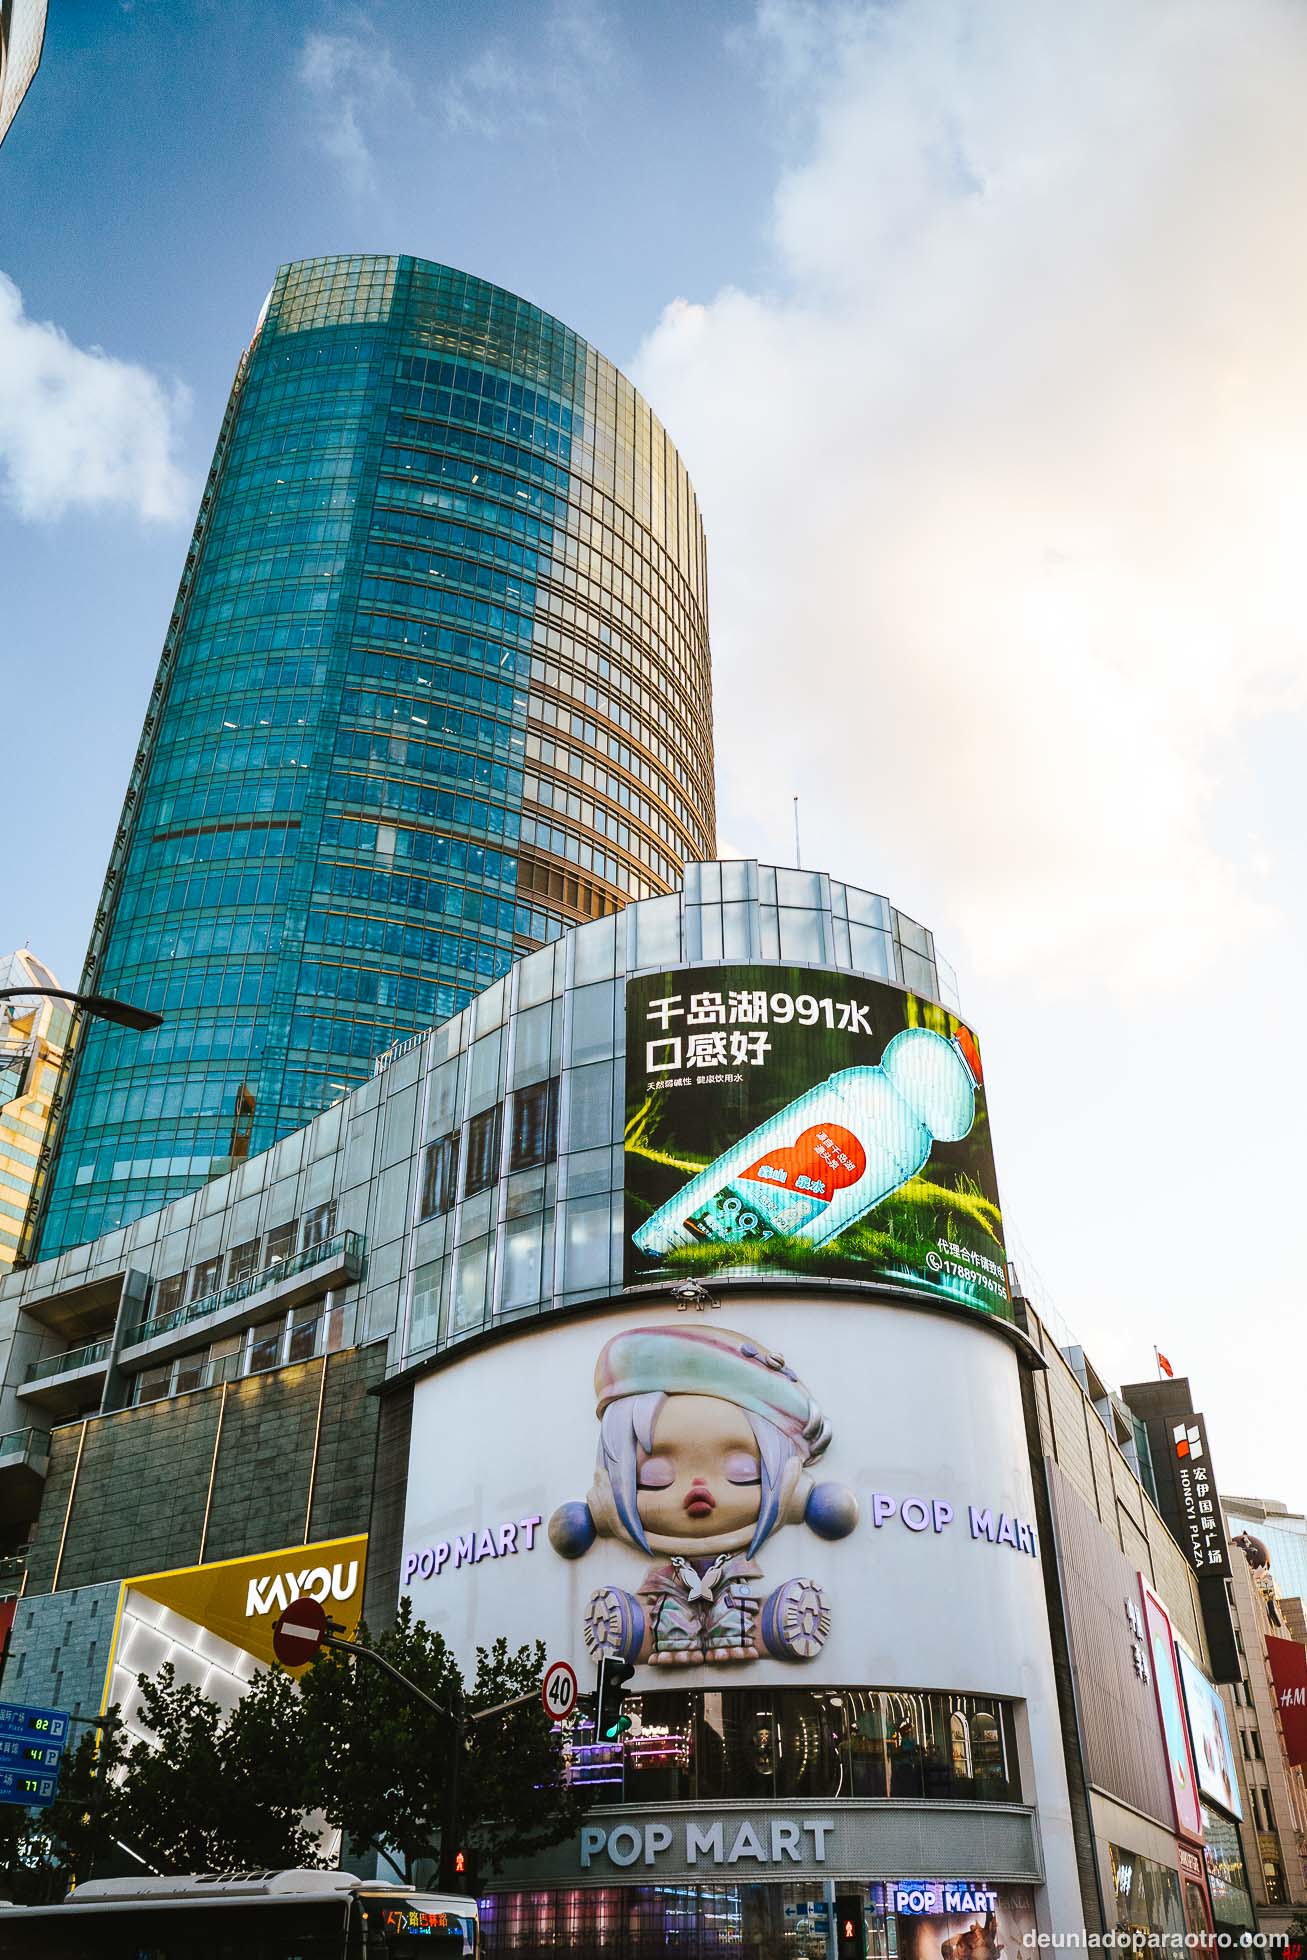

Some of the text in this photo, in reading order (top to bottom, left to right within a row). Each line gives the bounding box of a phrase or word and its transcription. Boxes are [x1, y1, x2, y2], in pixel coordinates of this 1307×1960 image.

[647, 990, 873, 1036] 千岛湖991水
[646, 1030, 772, 1073] 口感好
[696, 1073, 743, 1085] 健康饮用水
[944, 1260, 1008, 1300] 17889796755
[872, 1493, 1038, 1558] POP MART
[1179, 1469, 1204, 1568] HONGYI PLAZA
[1193, 1467, 1223, 1565] 宏伊国际广场
[404, 1515, 542, 1585] POP MART
[245, 1560, 359, 1617] KAYOU
[549, 1674, 571, 1706] 40
[35, 1719, 49, 1730] 82
[30, 1749, 43, 1760] 41
[25, 1780, 38, 1792] 77
[580, 1820, 835, 1868] POP MART
[896, 1890, 936, 1913] POP
[945, 1891, 998, 1913] MART
